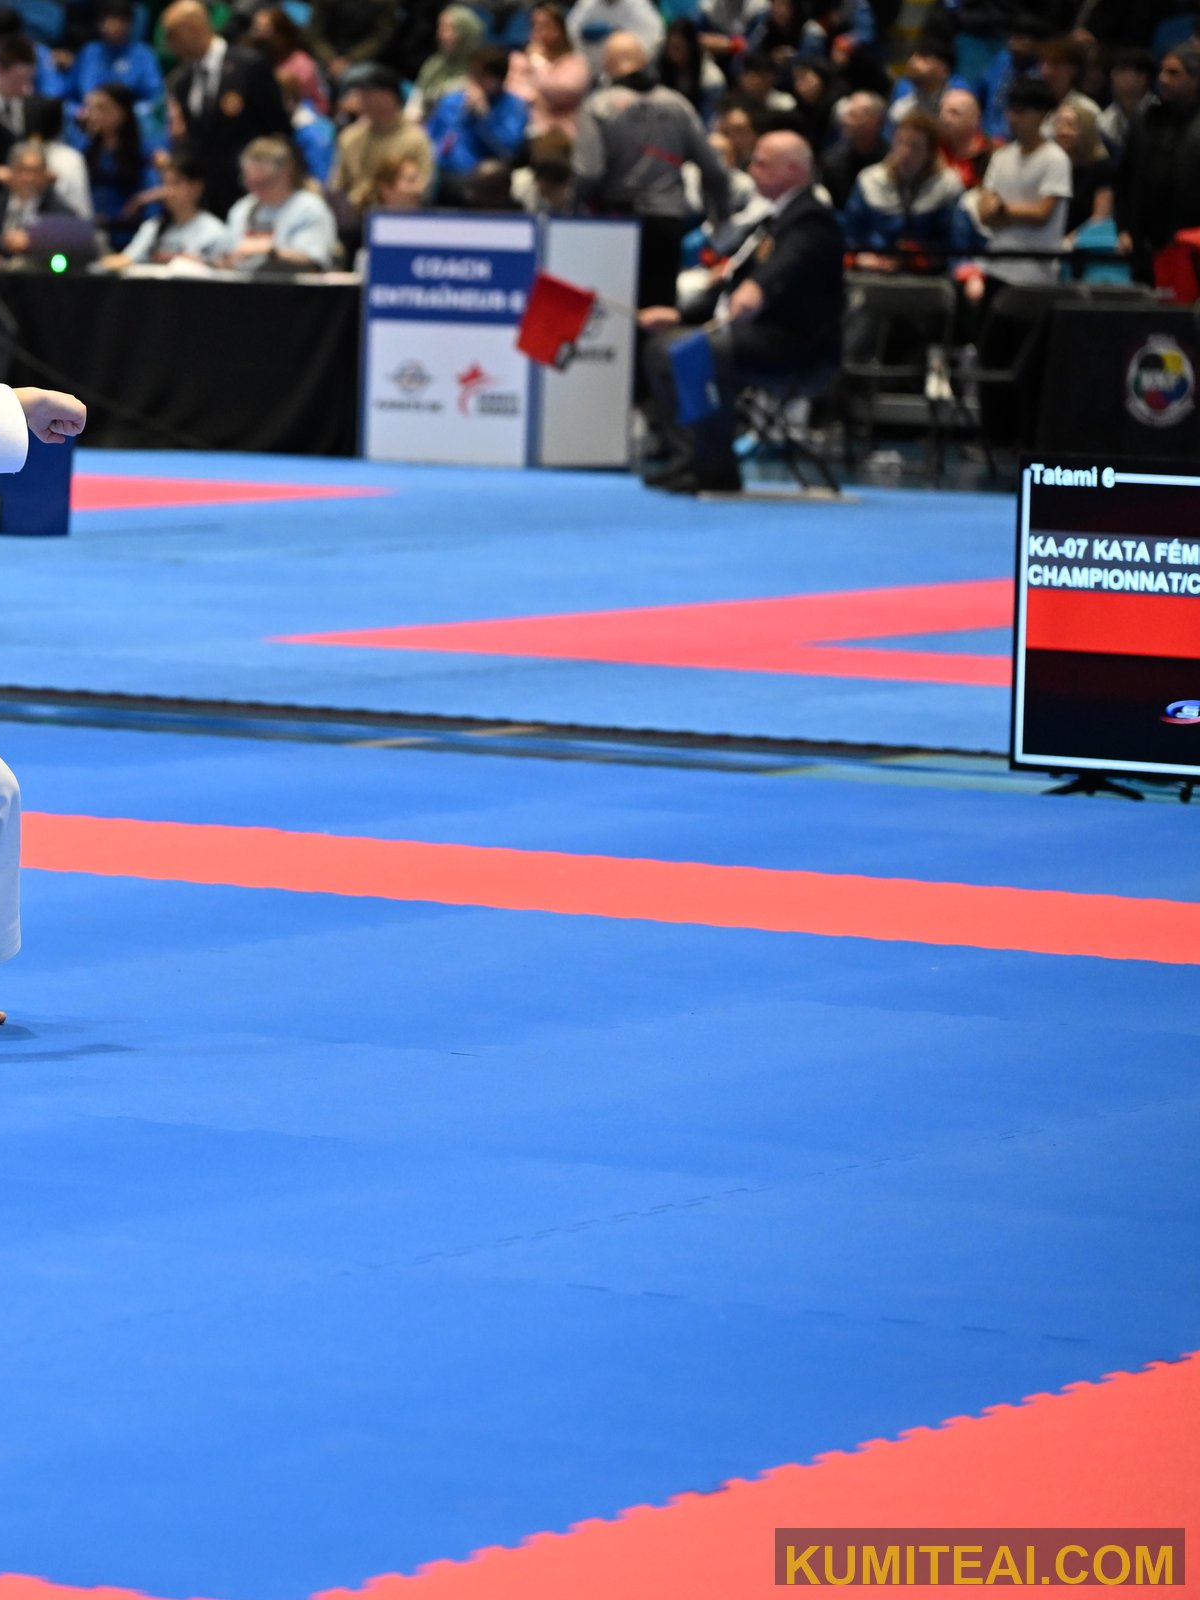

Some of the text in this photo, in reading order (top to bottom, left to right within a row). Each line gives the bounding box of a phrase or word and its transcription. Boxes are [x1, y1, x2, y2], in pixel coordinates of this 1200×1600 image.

[1030, 463, 1116, 488] Tatami 6
[1028, 535, 1089, 560] KA-07
[1092, 538, 1151, 564] KATA
